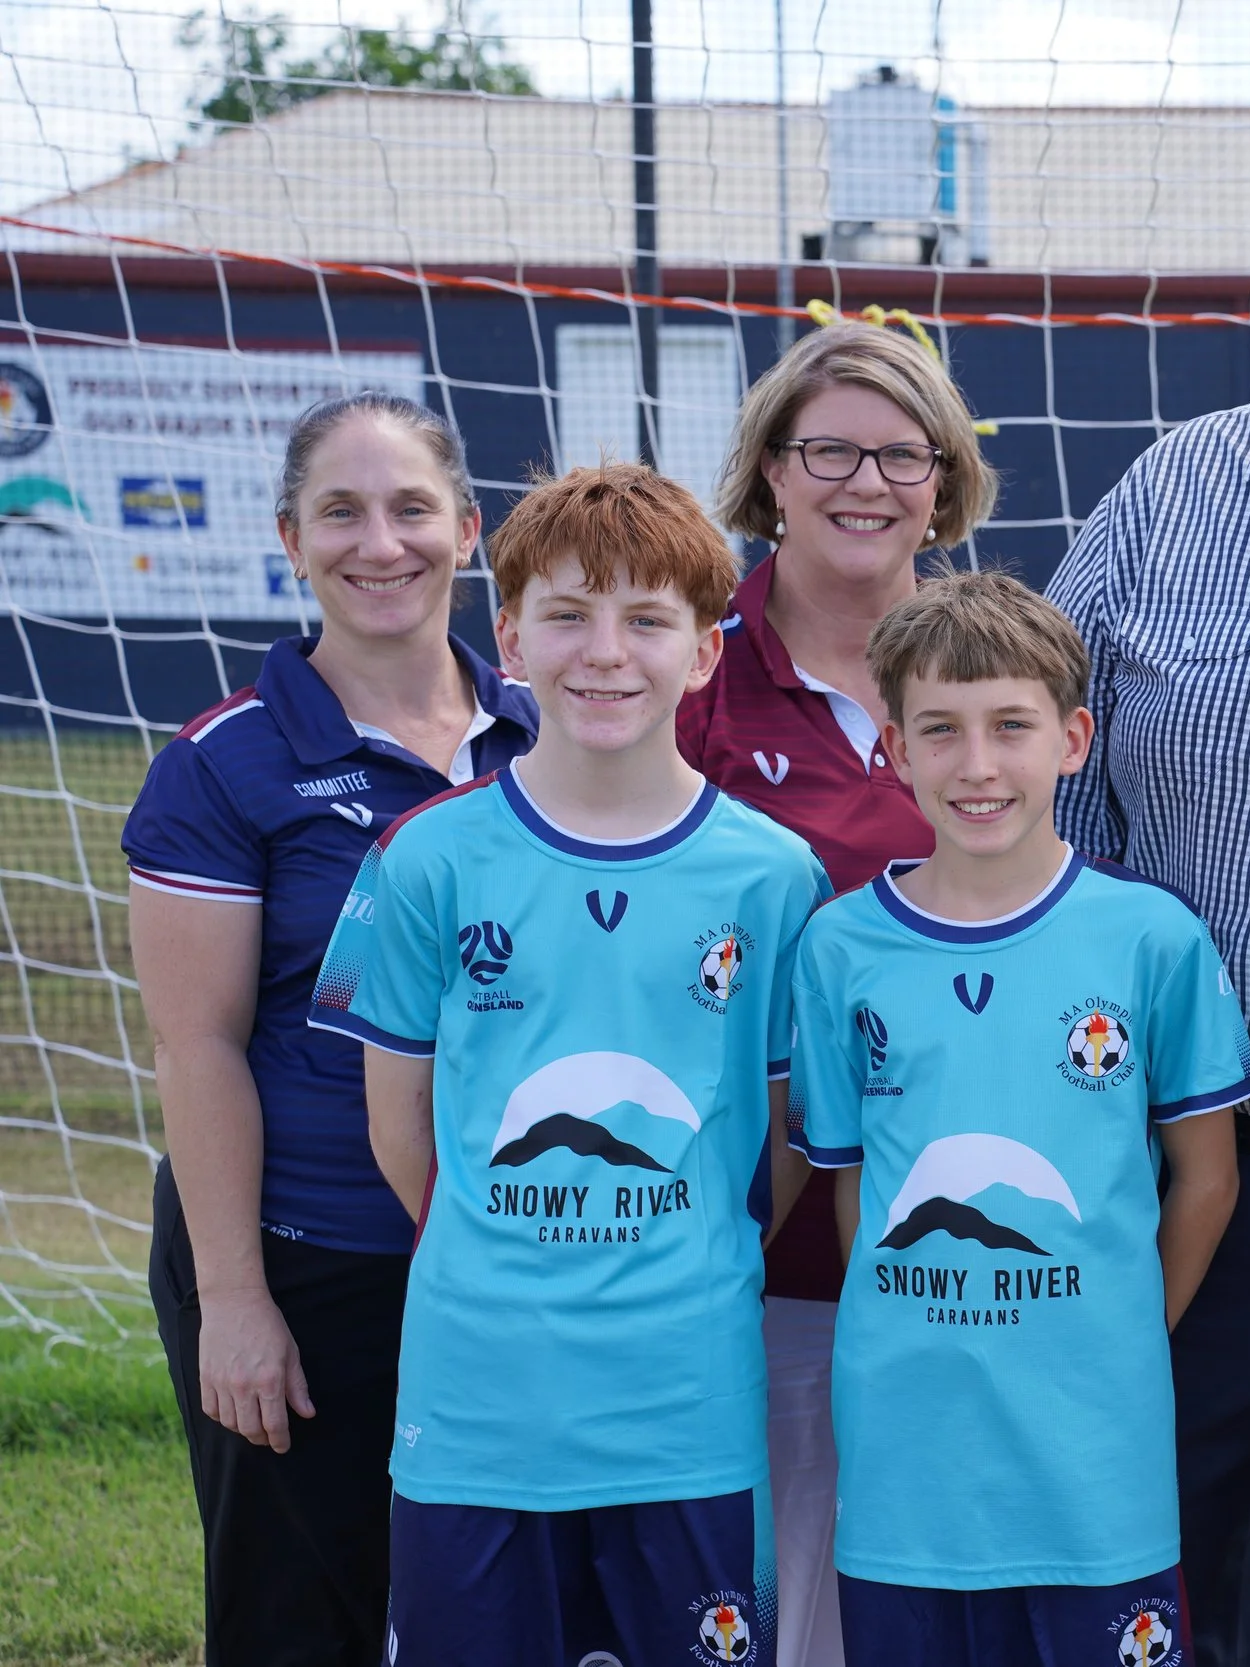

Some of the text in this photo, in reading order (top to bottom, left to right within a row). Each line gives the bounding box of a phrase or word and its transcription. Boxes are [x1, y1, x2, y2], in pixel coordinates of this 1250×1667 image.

[293, 770, 372, 797] COMMITTEE
[693, 922, 755, 951] MA Olmpic
[687, 983, 728, 1015] Footba
[1059, 1004, 1082, 1025] MA
[1056, 1060, 1136, 1092] Football Club
[487, 1179, 692, 1218] SNOWY RIVER
[538, 1226, 641, 1243] CARAVANS
[875, 1264, 1082, 1301] SNOWY RIVER
[927, 1307, 1020, 1326] CARAVANS
[688, 1590, 749, 1614] MA Olympic
[1106, 1597, 1178, 1635] MA Olympic
